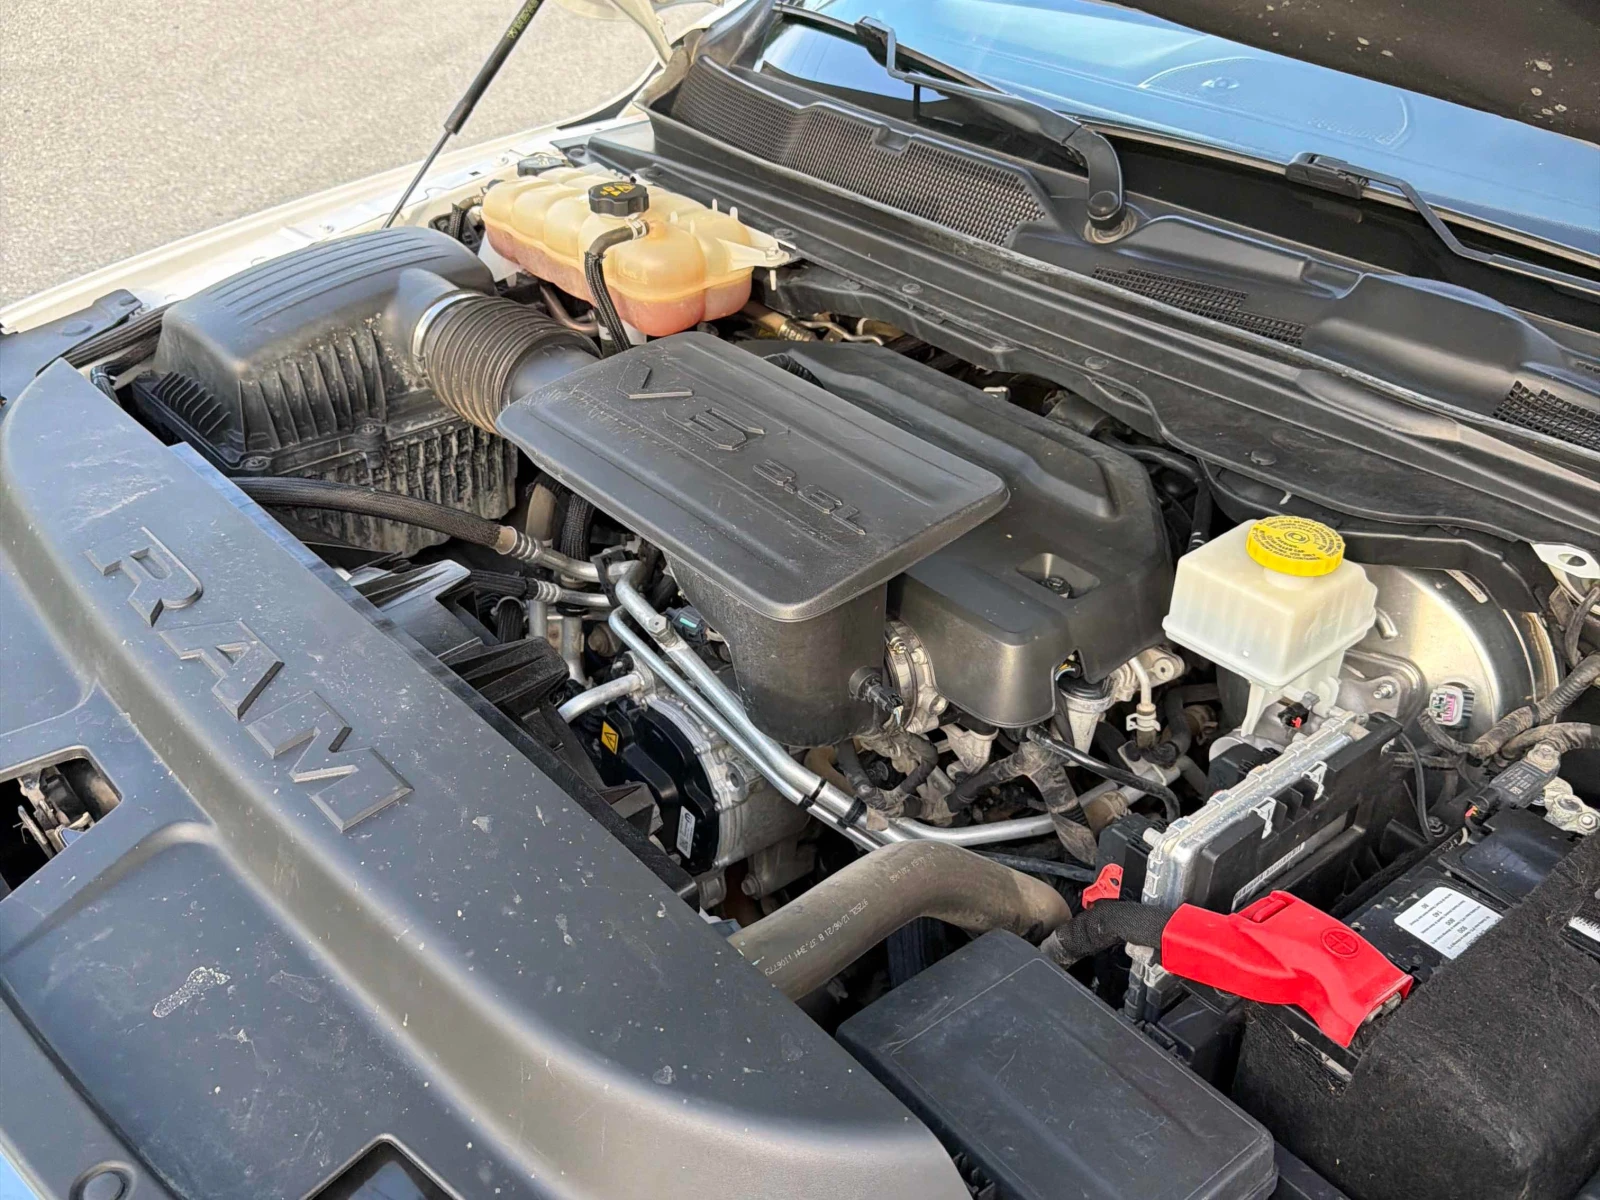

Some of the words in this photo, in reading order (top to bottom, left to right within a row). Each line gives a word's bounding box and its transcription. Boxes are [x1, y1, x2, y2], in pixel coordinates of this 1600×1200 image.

[617, 360, 766, 450] V6
[753, 459, 867, 535] 3.6L
[84, 526, 415, 833] RAM
[824, 913, 851, 937] 12/06/21
